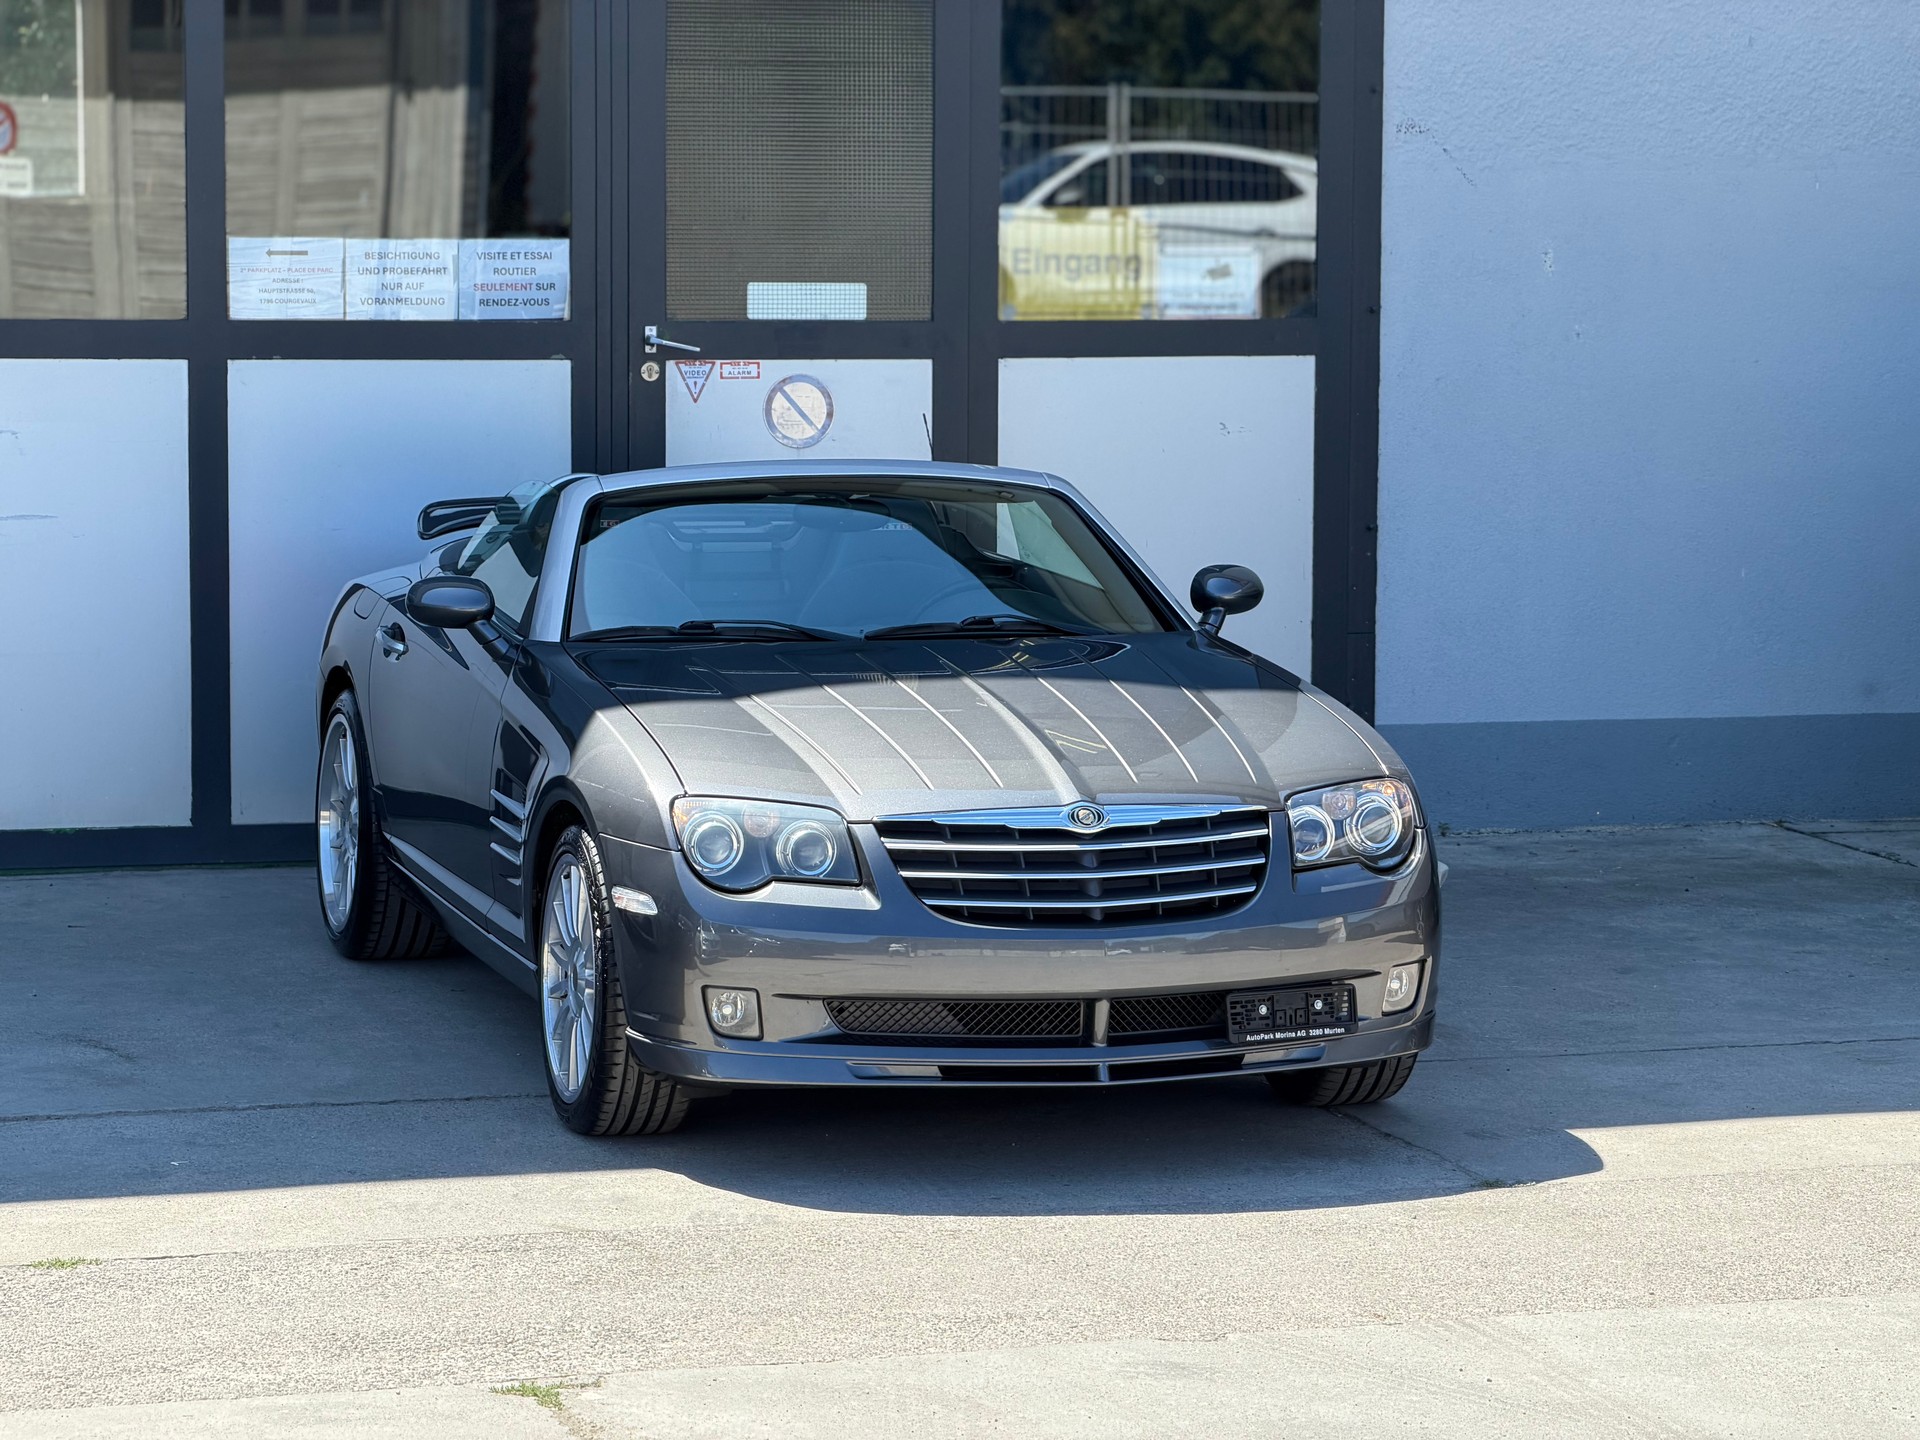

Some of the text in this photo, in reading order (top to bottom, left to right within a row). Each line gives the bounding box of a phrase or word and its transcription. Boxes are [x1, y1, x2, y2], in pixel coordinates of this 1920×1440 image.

[364, 251, 441, 261] BESICHTIGUNG
[476, 251, 553, 261] VISITE ET ESSAI
[1012, 247, 1143, 283] Eingang
[357, 266, 448, 276] UND PROBEFAHRT
[493, 267, 537, 277] ROUTIER
[381, 282, 425, 291] NUR AUF
[473, 282, 556, 292] SEULEMENT SUR
[360, 297, 446, 306] VORANMELDUNG
[479, 298, 550, 307] RENDEZ-VOUS
[1246, 1033, 1274, 1041] AutoPark
[1275, 1031, 1296, 1039] Morina
[1324, 1027, 1345, 1035] Murten
